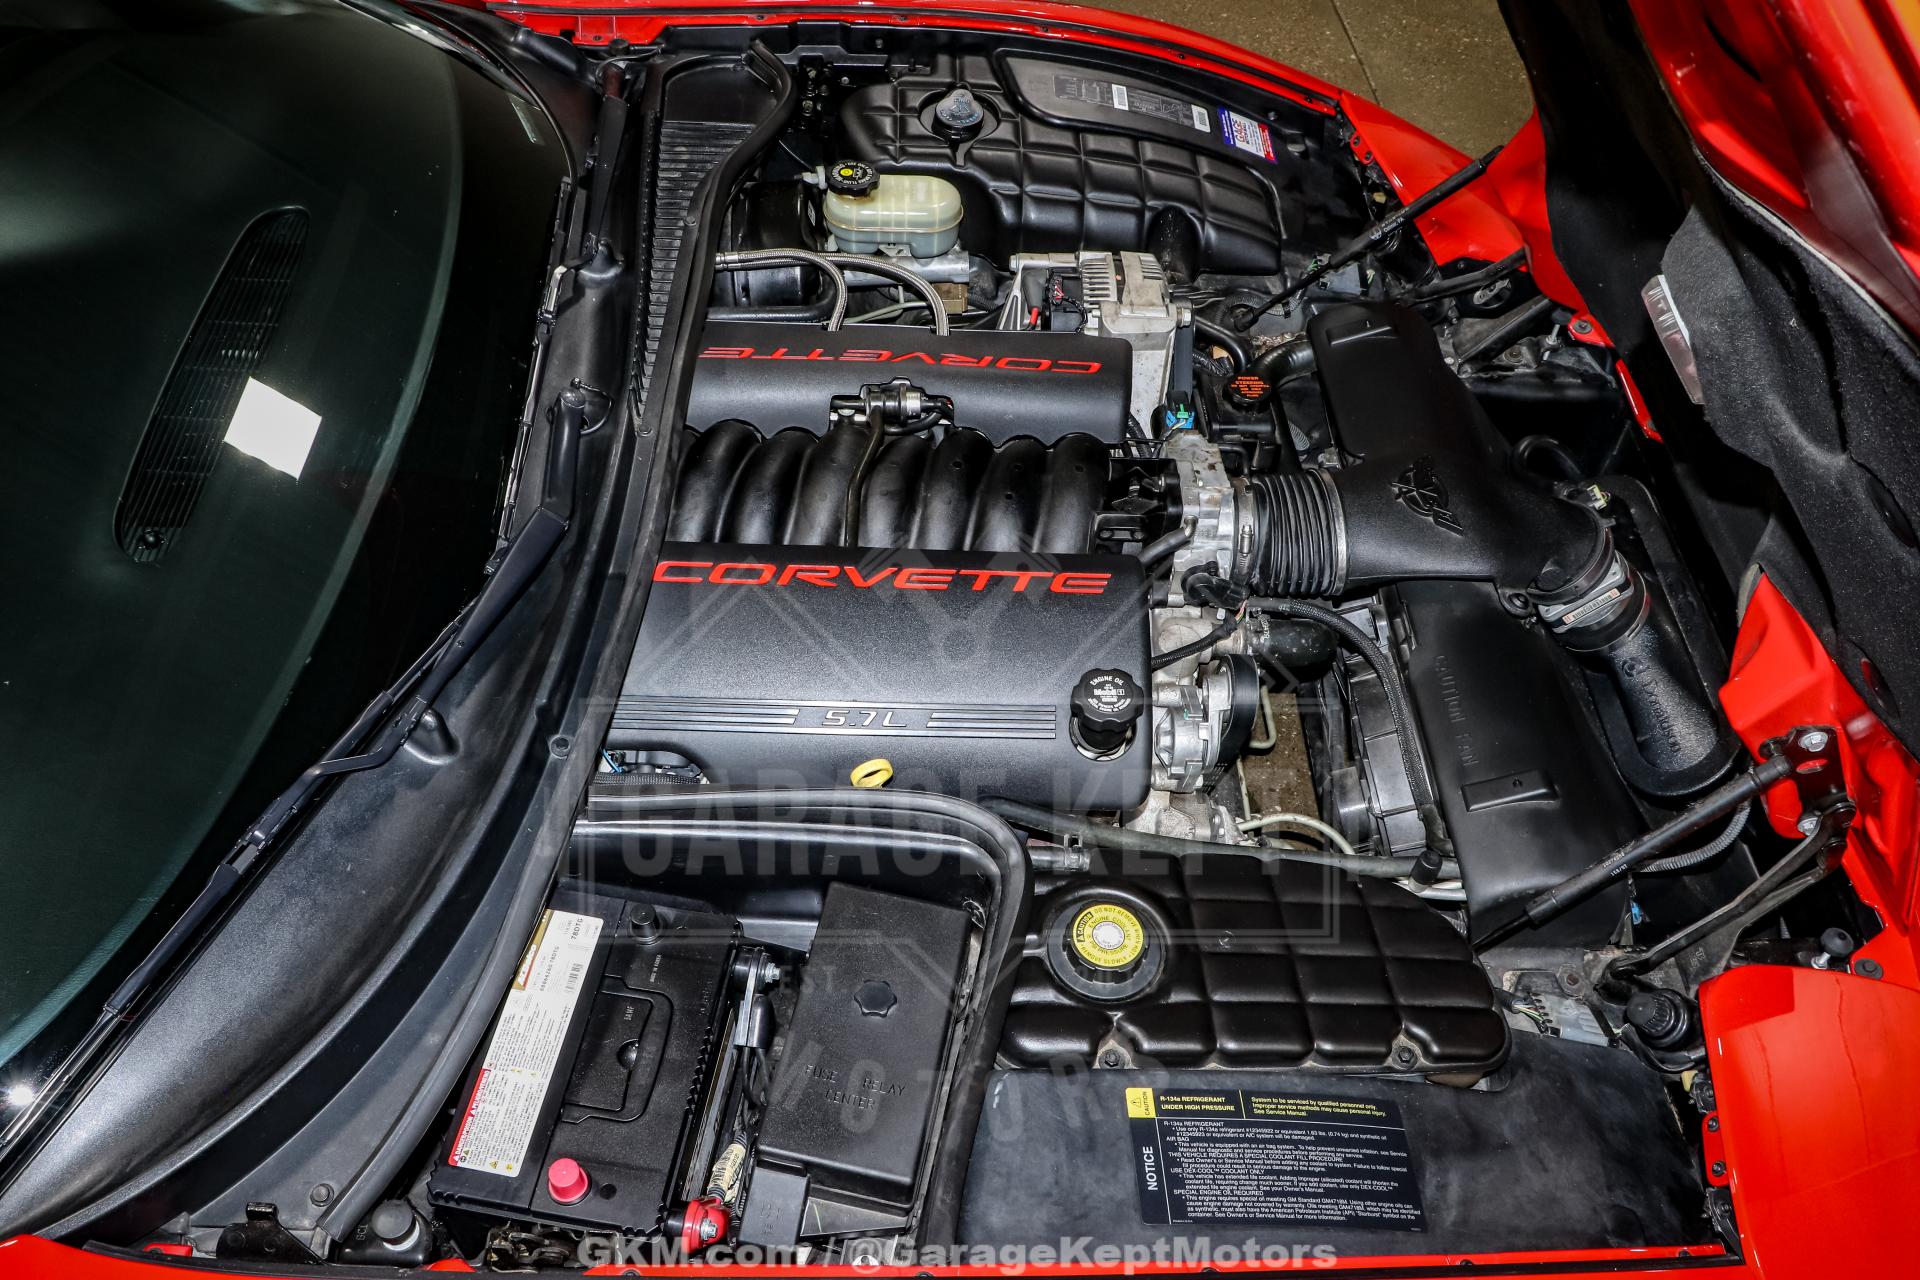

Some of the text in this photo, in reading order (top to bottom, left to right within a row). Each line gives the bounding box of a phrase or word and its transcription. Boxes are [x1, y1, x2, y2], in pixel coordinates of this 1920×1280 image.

[700, 346, 1102, 373] CORVETTE
[653, 560, 1112, 594] CORVETTE
[1089, 676, 1124, 686] ENGINE OIL
[822, 711, 908, 728] 5.7L
[1641, 678, 1683, 754] Donaldson
[806, 1064, 906, 1096] FUSE RELAY
[825, 1089, 875, 1110] CENTER
[1142, 1146, 1158, 1190] NOTICE
